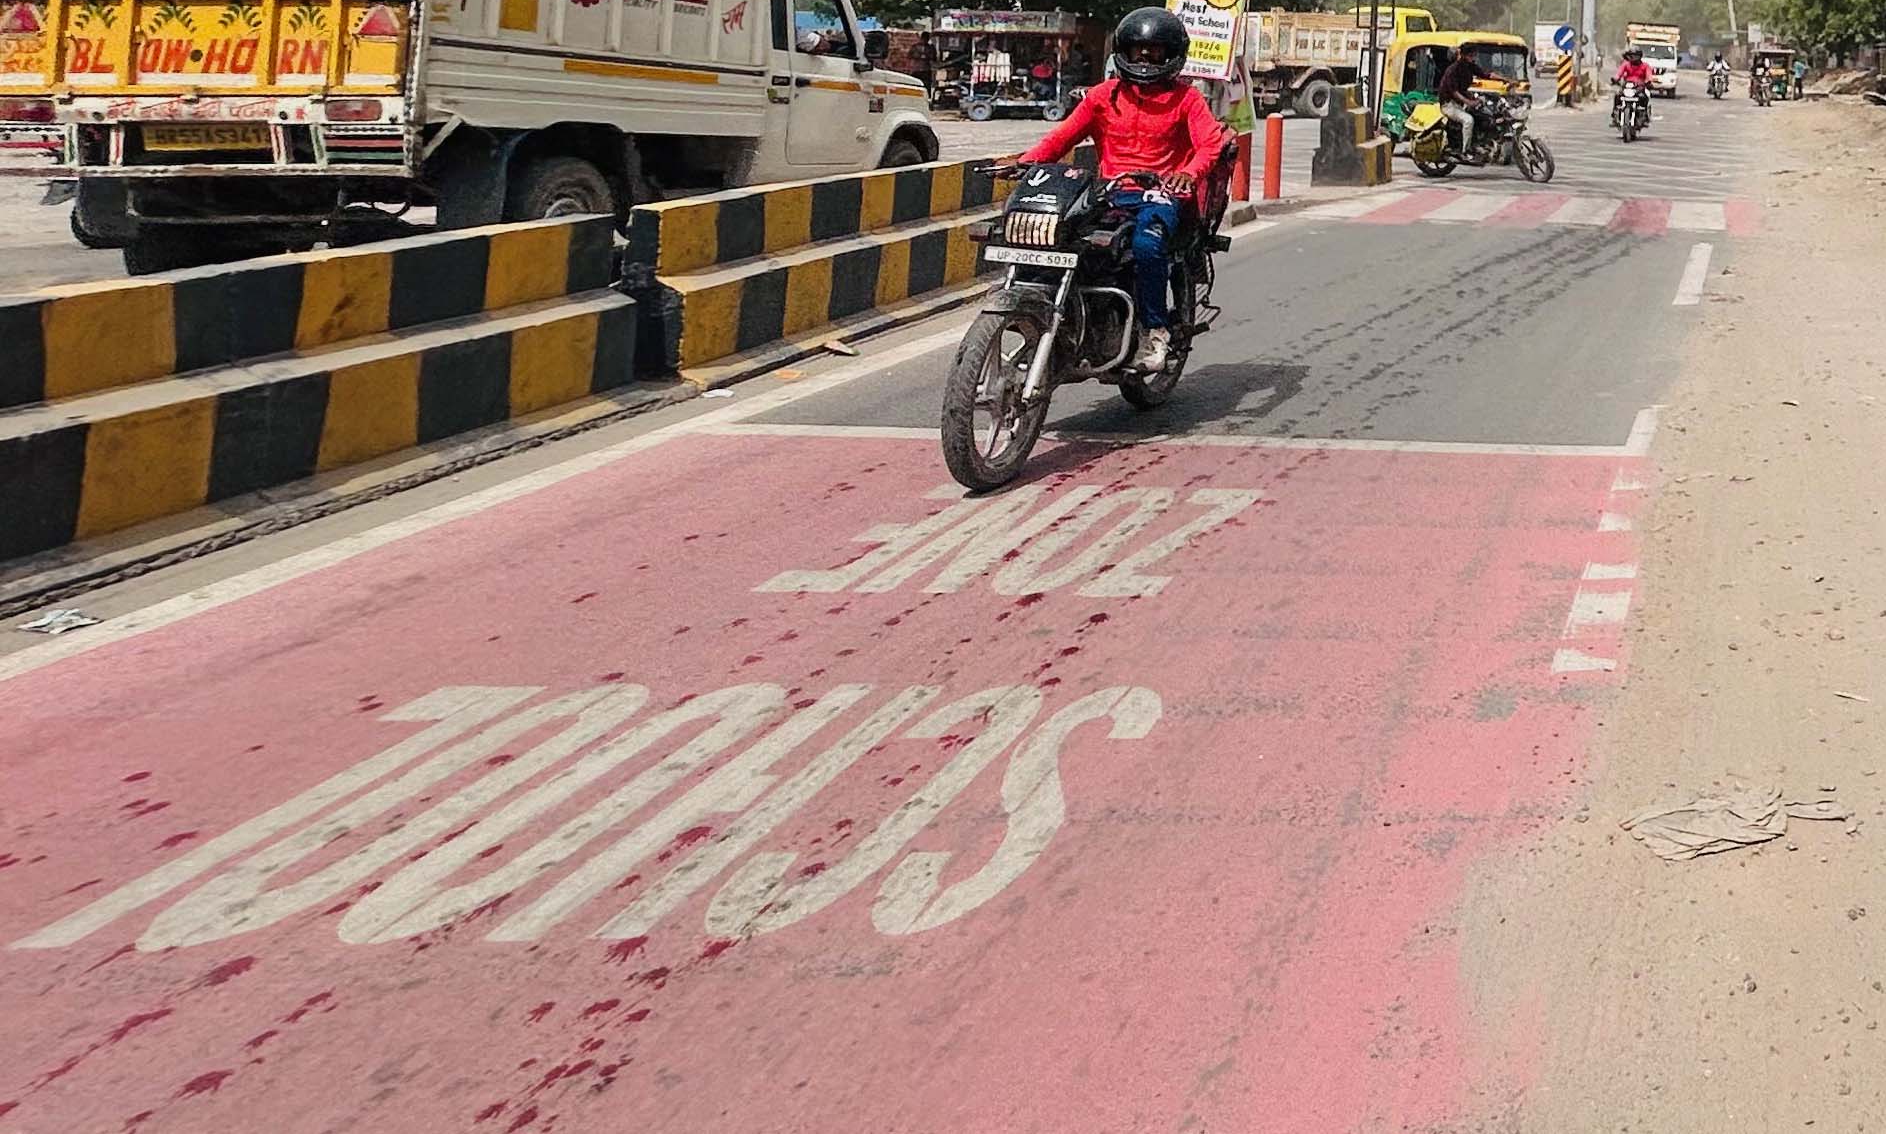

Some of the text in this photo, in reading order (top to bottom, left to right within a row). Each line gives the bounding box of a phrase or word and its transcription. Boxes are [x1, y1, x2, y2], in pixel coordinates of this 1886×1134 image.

[70, 37, 194, 74] BLOW
[201, 37, 328, 74] HORN
[1198, 16, 1229, 30] School
[751, 483, 1265, 597] ZONE
[5, 684, 1163, 951] SCHOOL
